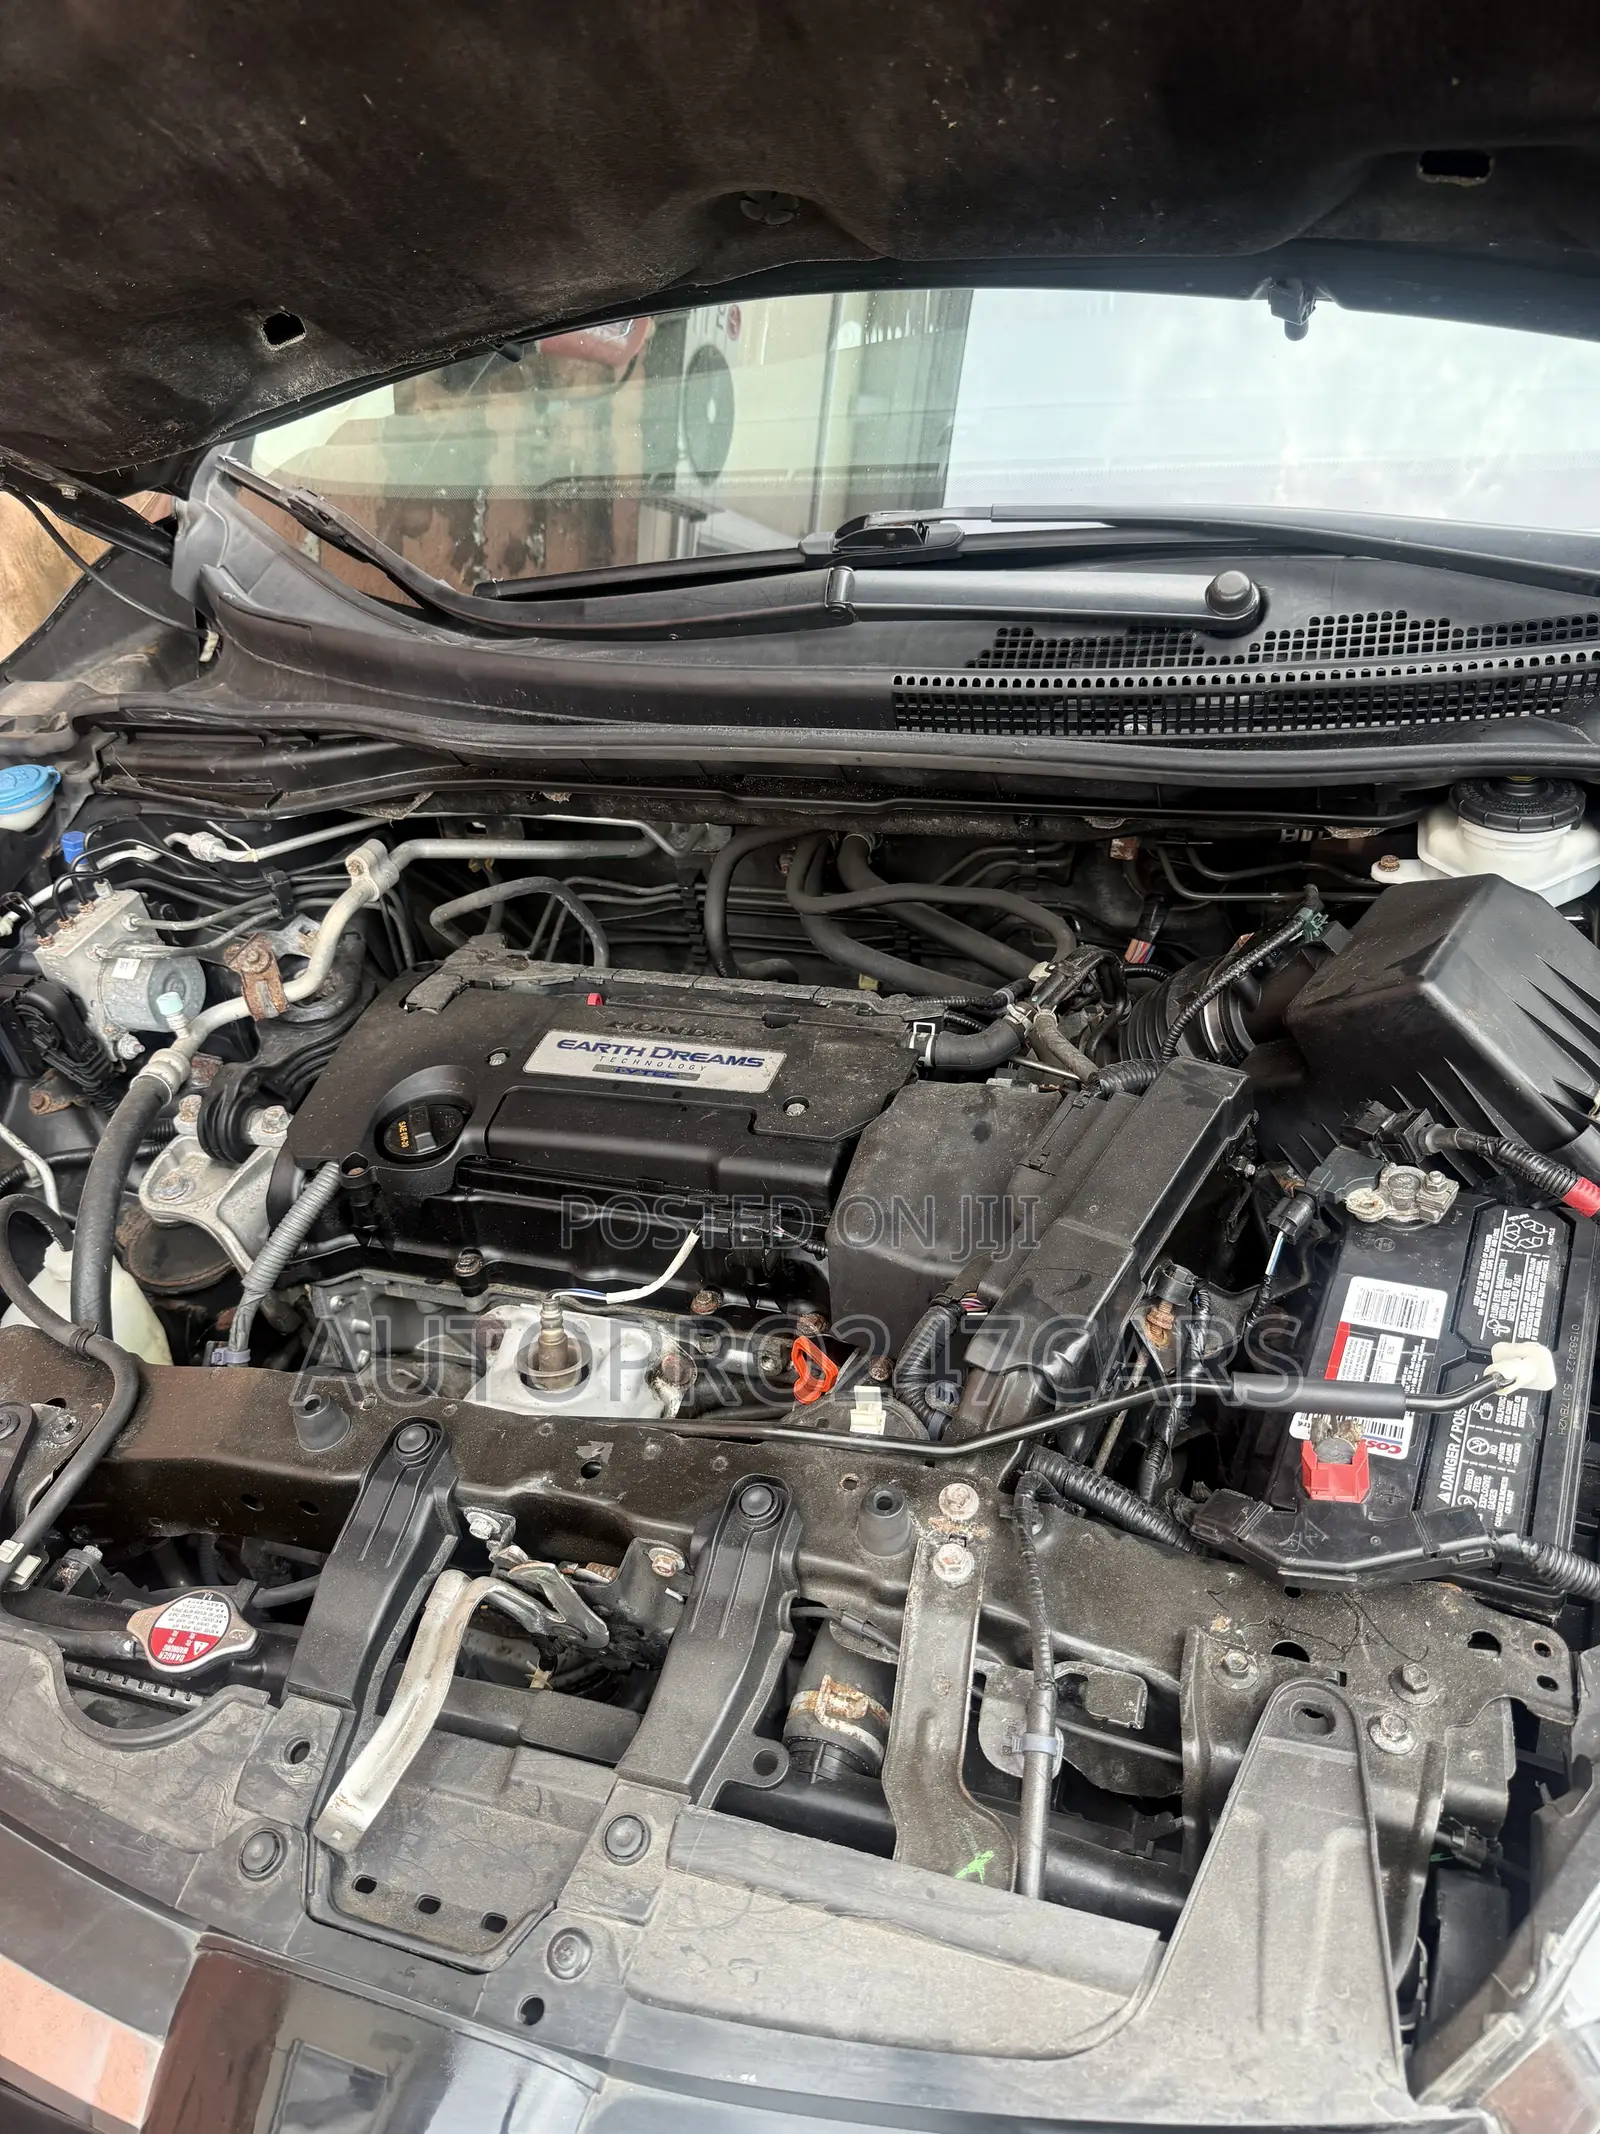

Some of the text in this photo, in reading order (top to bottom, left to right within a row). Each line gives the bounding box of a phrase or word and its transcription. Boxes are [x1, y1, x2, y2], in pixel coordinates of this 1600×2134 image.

[556, 1039, 765, 1068] EARTH DREAMS
[600, 1056, 707, 1071] TECHNOLOGY
[1504, 1278, 1512, 1288] GET
[1493, 1290, 1501, 1301] EYES
[1507, 1274, 1521, 1321] MEDICAL HELP FAST
[1490, 1303, 1499, 1318] FLUSH
[1566, 1324, 1580, 1372] 01582422
[1364, 1438, 1402, 1454] COS
[1440, 1408, 1466, 1490] DANGER / POIS
[1489, 1445, 1497, 1454] NO
[1464, 1469, 1474, 1490] SHIELD
[1472, 1476, 1482, 1492] EYES
[1477, 1475, 1491, 1508] EXPLOSIVE
[1486, 1489, 1497, 1509] GASES
[158, 1652, 185, 1661] DANGER
